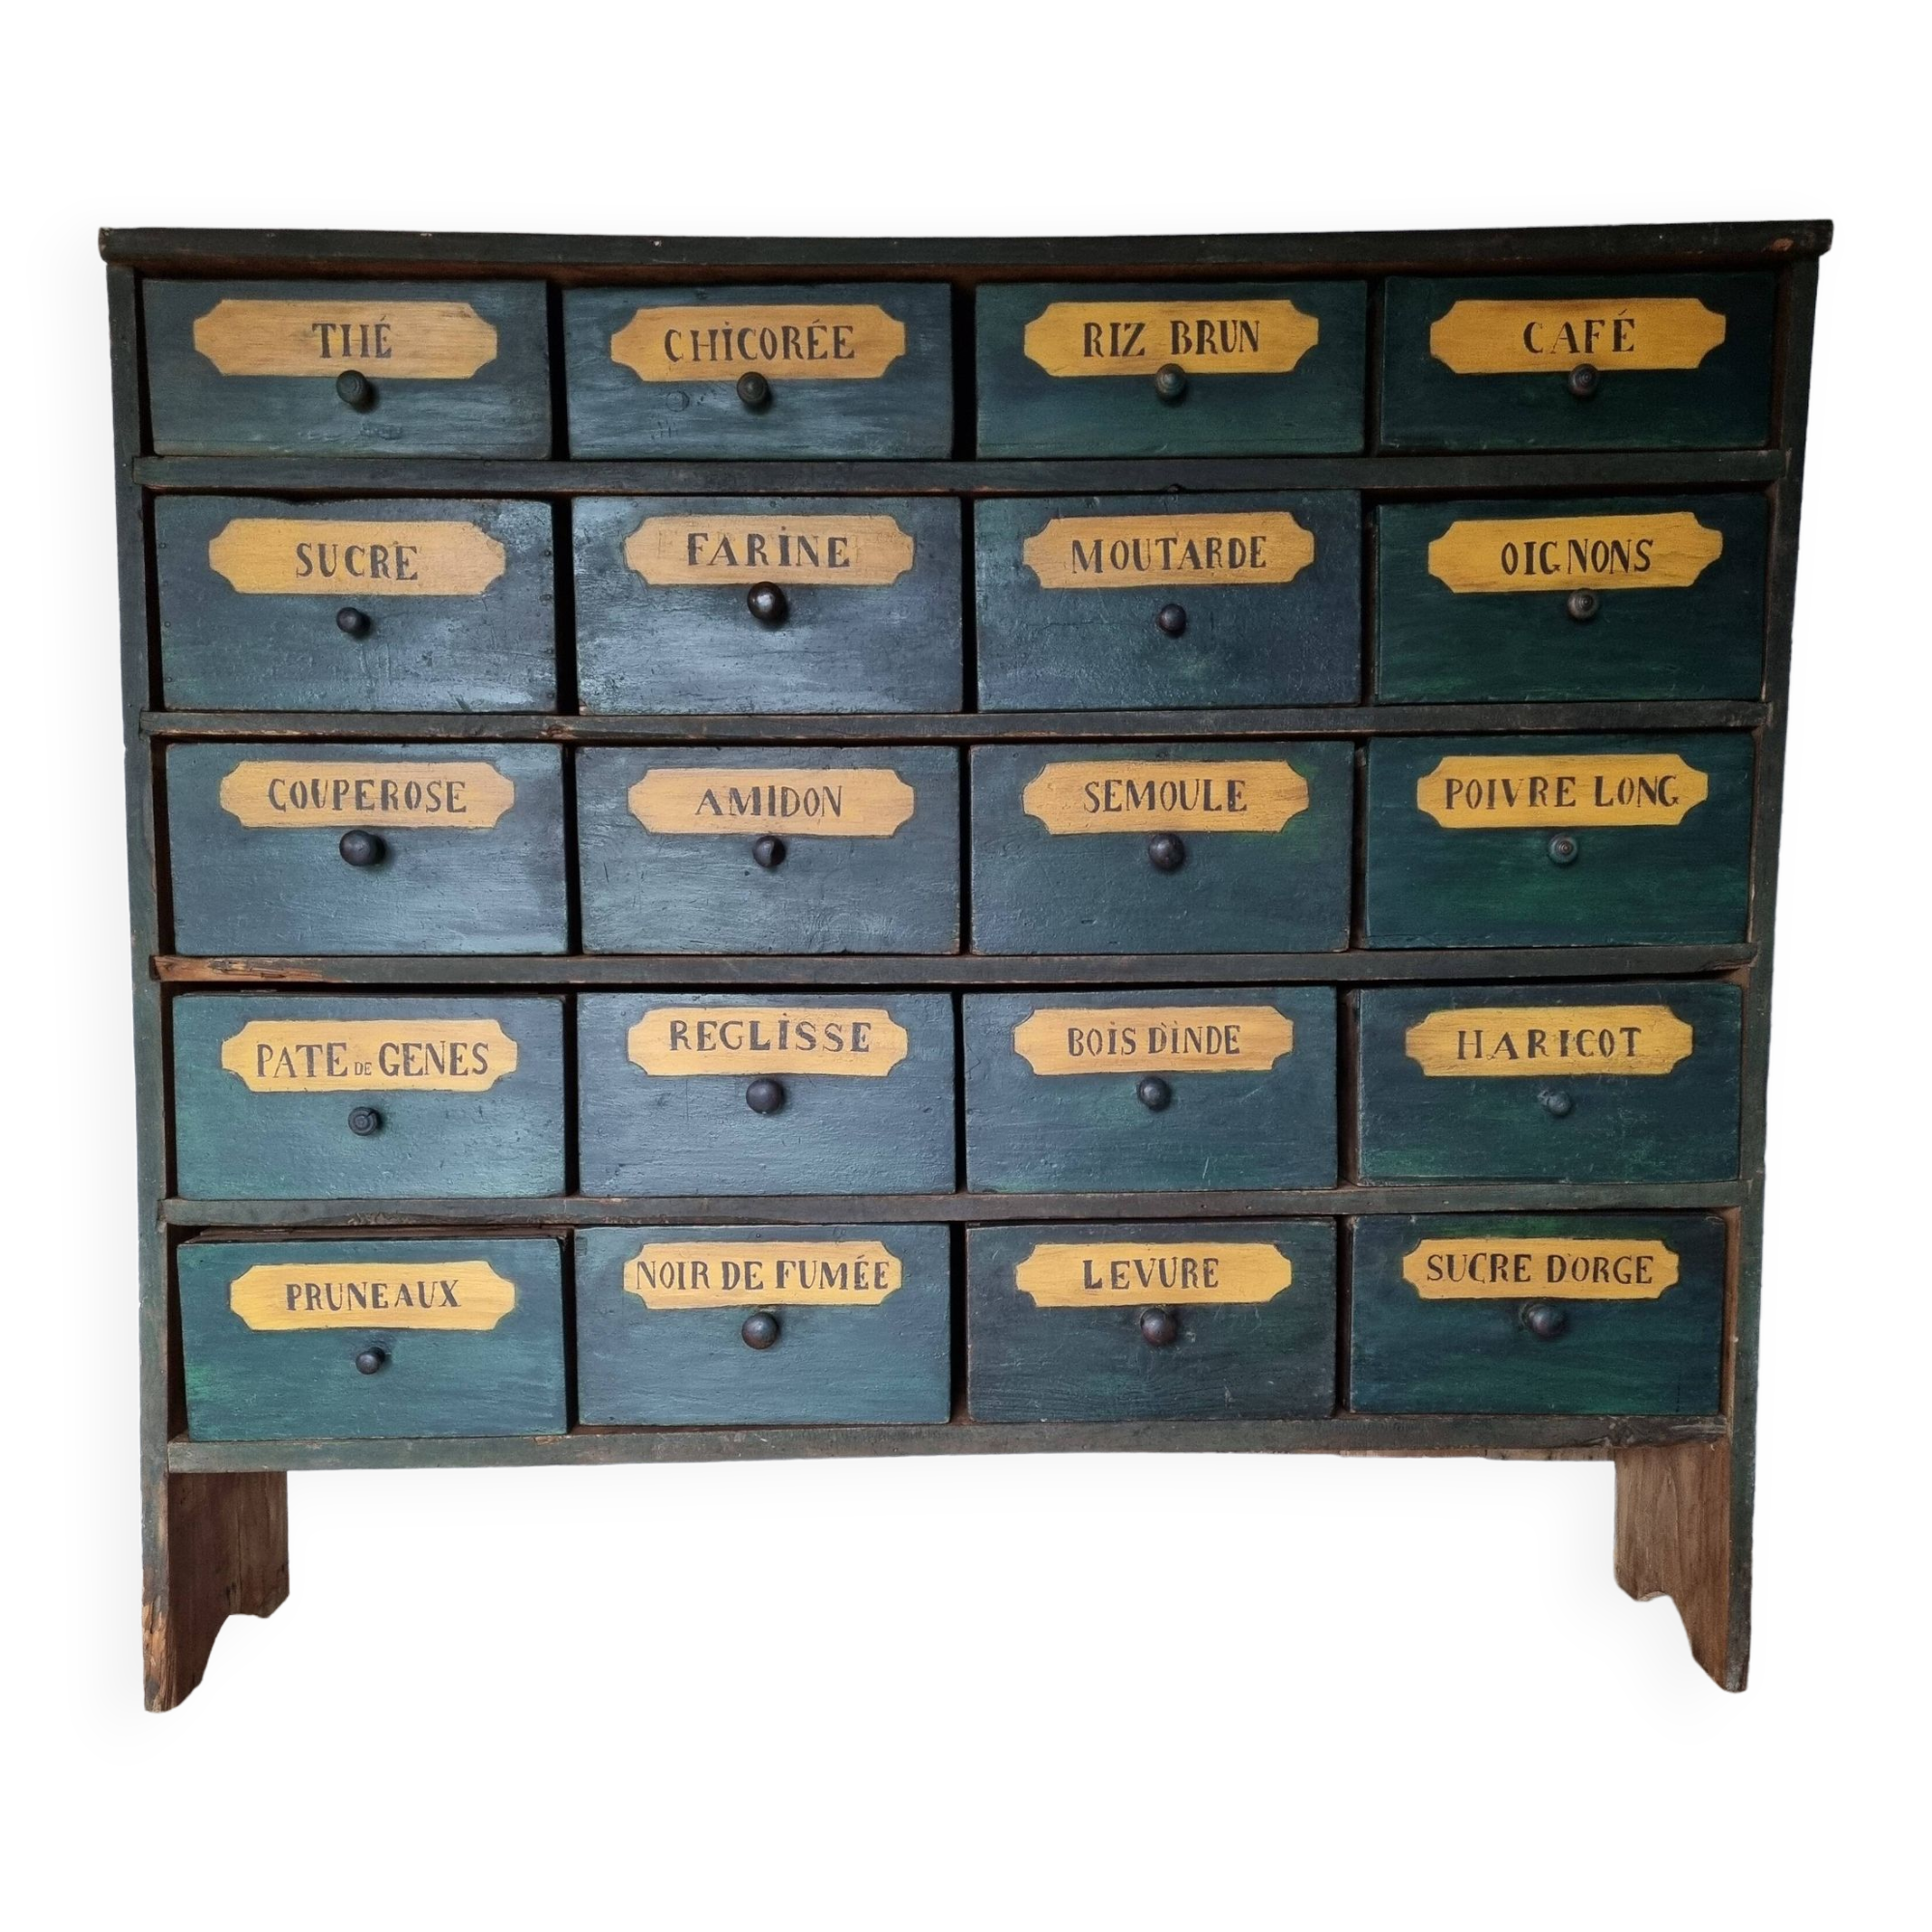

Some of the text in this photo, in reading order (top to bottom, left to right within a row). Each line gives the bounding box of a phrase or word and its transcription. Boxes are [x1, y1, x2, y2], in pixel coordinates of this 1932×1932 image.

[1083, 319, 1261, 358] RIZ BRUN
[1523, 310, 1635, 355] CAFÉ
[296, 542, 418, 581] SUCRE
[1071, 535, 1267, 573] MOUTARDE
[1501, 537, 1655, 576] OIGNONS
[268, 778, 468, 813] COUPEROSE
[695, 784, 843, 817] AMIDON
[1083, 778, 1247, 813] SEMOULE
[1445, 774, 1680, 810] POIVRE LONG
[256, 1039, 490, 1078] PATE DE GENES
[1456, 1027, 1641, 1061] HARICOT
[635, 1254, 891, 1292] NOIR DE FUMÉE
[1083, 1257, 1220, 1291] LEVURE
[1426, 1253, 1533, 1284] SUCRE
[286, 1279, 462, 1311] PRUNEAUX
